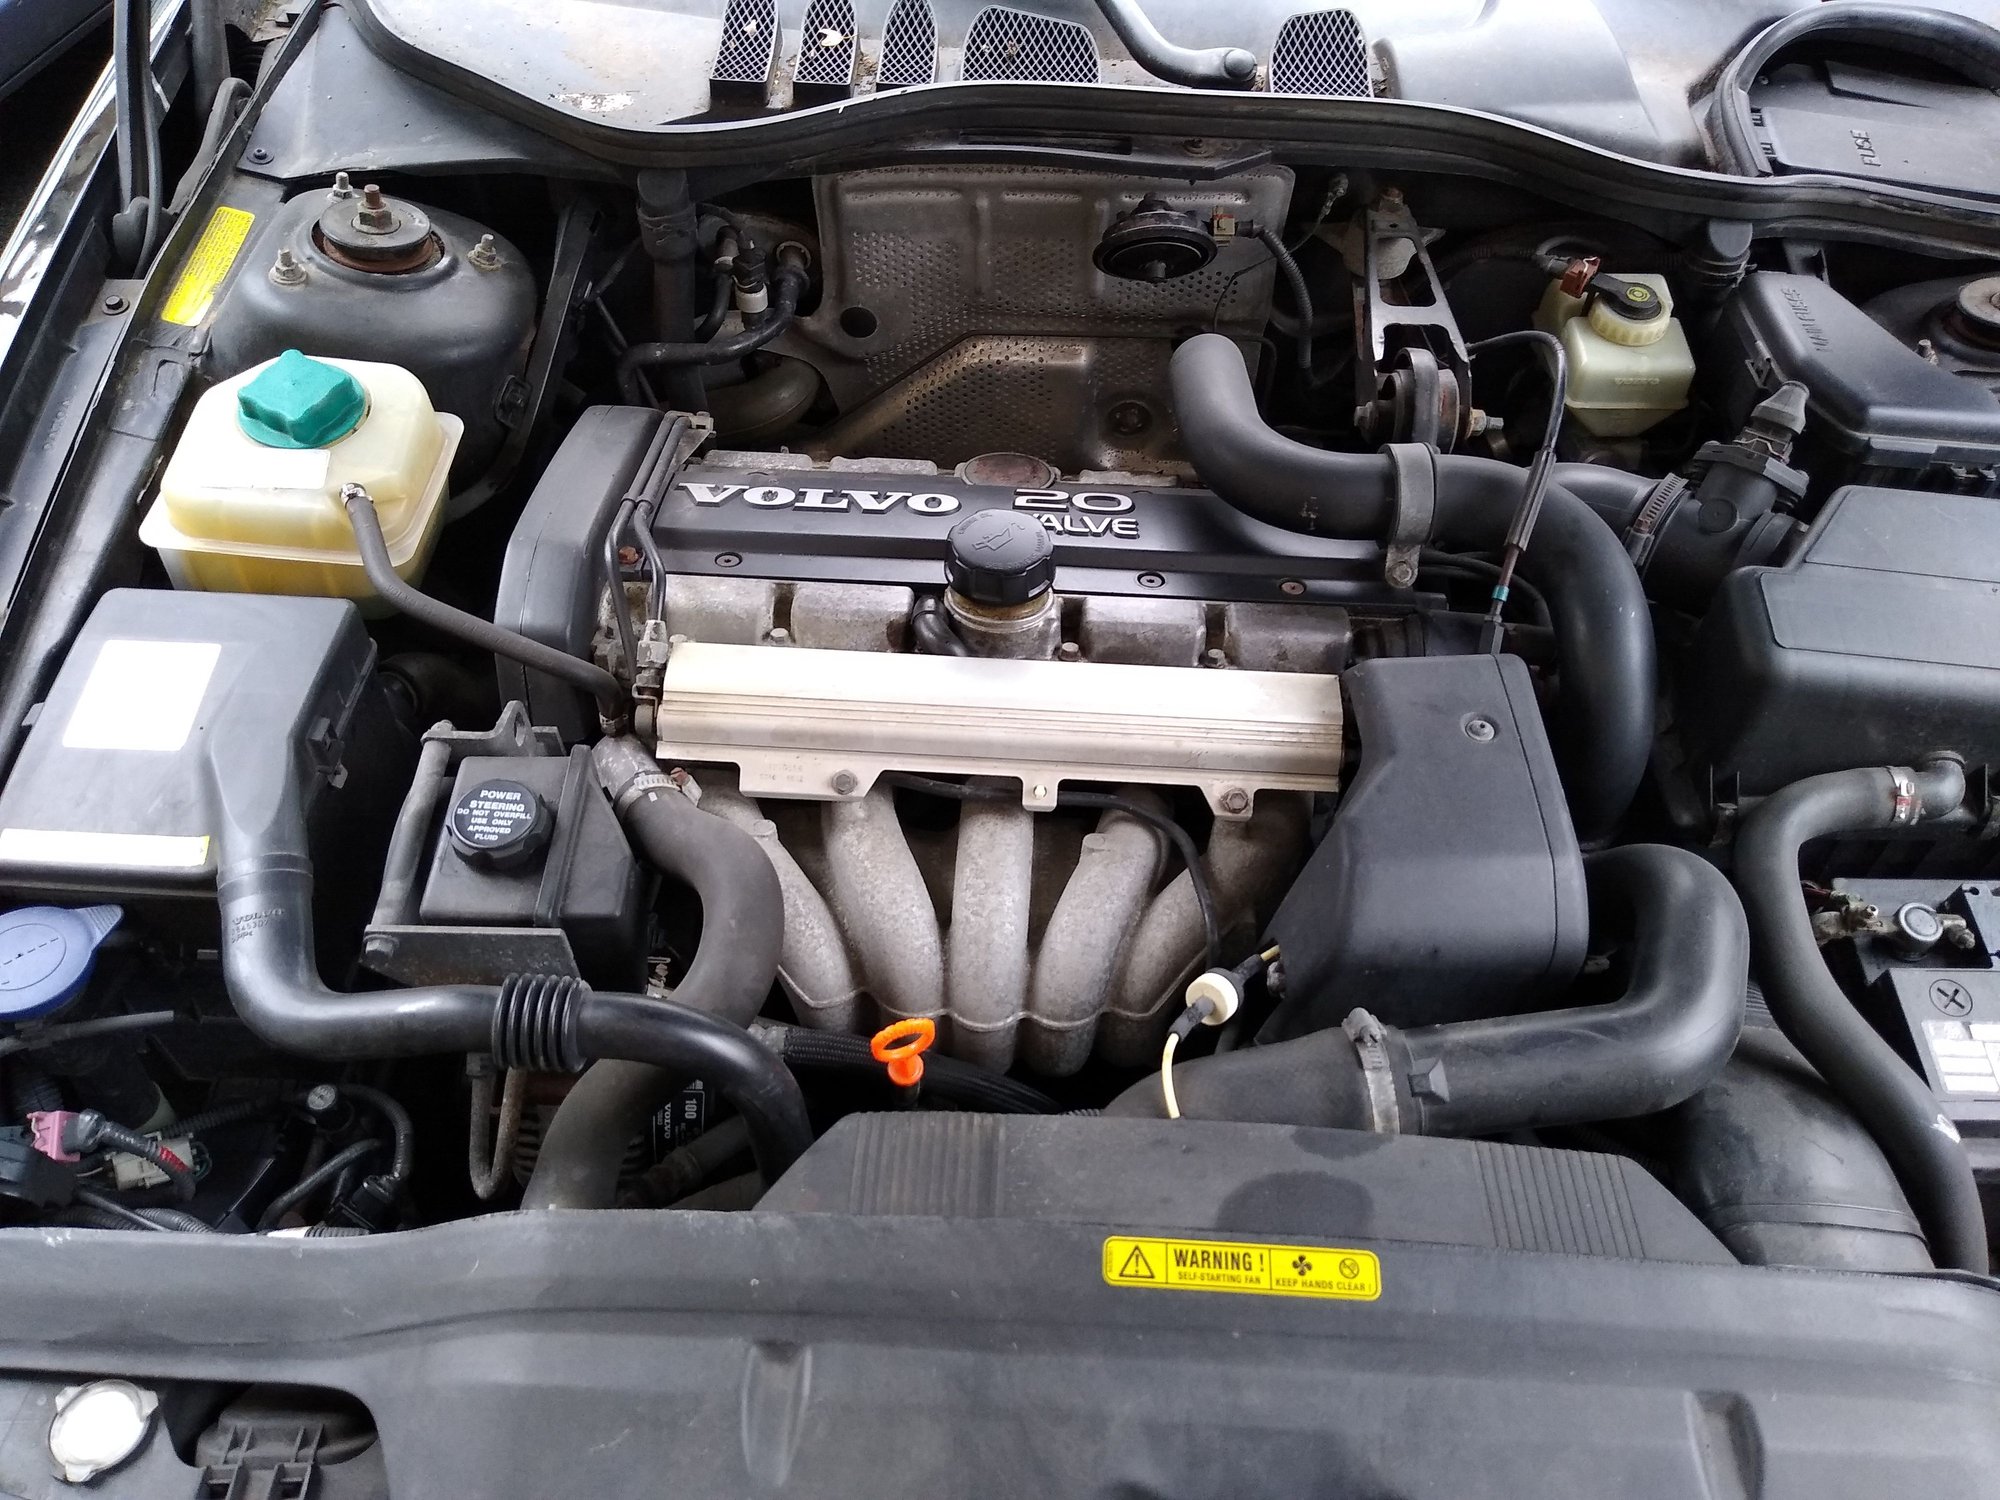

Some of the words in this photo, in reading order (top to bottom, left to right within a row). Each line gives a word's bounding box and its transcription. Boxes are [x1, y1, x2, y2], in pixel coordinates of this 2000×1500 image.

[1850, 129, 1881, 167] FUSE
[677, 482, 961, 515] VOLVO
[1014, 488, 1134, 513] 20
[1032, 513, 1140, 537] ALVE
[480, 789, 522, 801] POWER
[469, 799, 525, 812] STEERING
[456, 807, 470, 815] DO
[472, 809, 490, 817] NOT
[493, 810, 532, 820] OVERFILL
[467, 824, 512, 834] APPROVED
[470, 817, 488, 825] USE
[491, 818, 514, 826] ONLY
[474, 833, 499, 841] FLUID
[684, 1098, 698, 1119] 100
[663, 1101, 672, 1139] VOLVO
[1173, 1248, 1253, 1272] WARNING
[1178, 1270, 1242, 1284] SELF-STARTING
[1244, 1275, 1261, 1285] FAN
[1275, 1277, 1298, 1287] KEEP
[1301, 1279, 1334, 1290] HANDS
[1336, 1281, 1366, 1292] CLEAR
